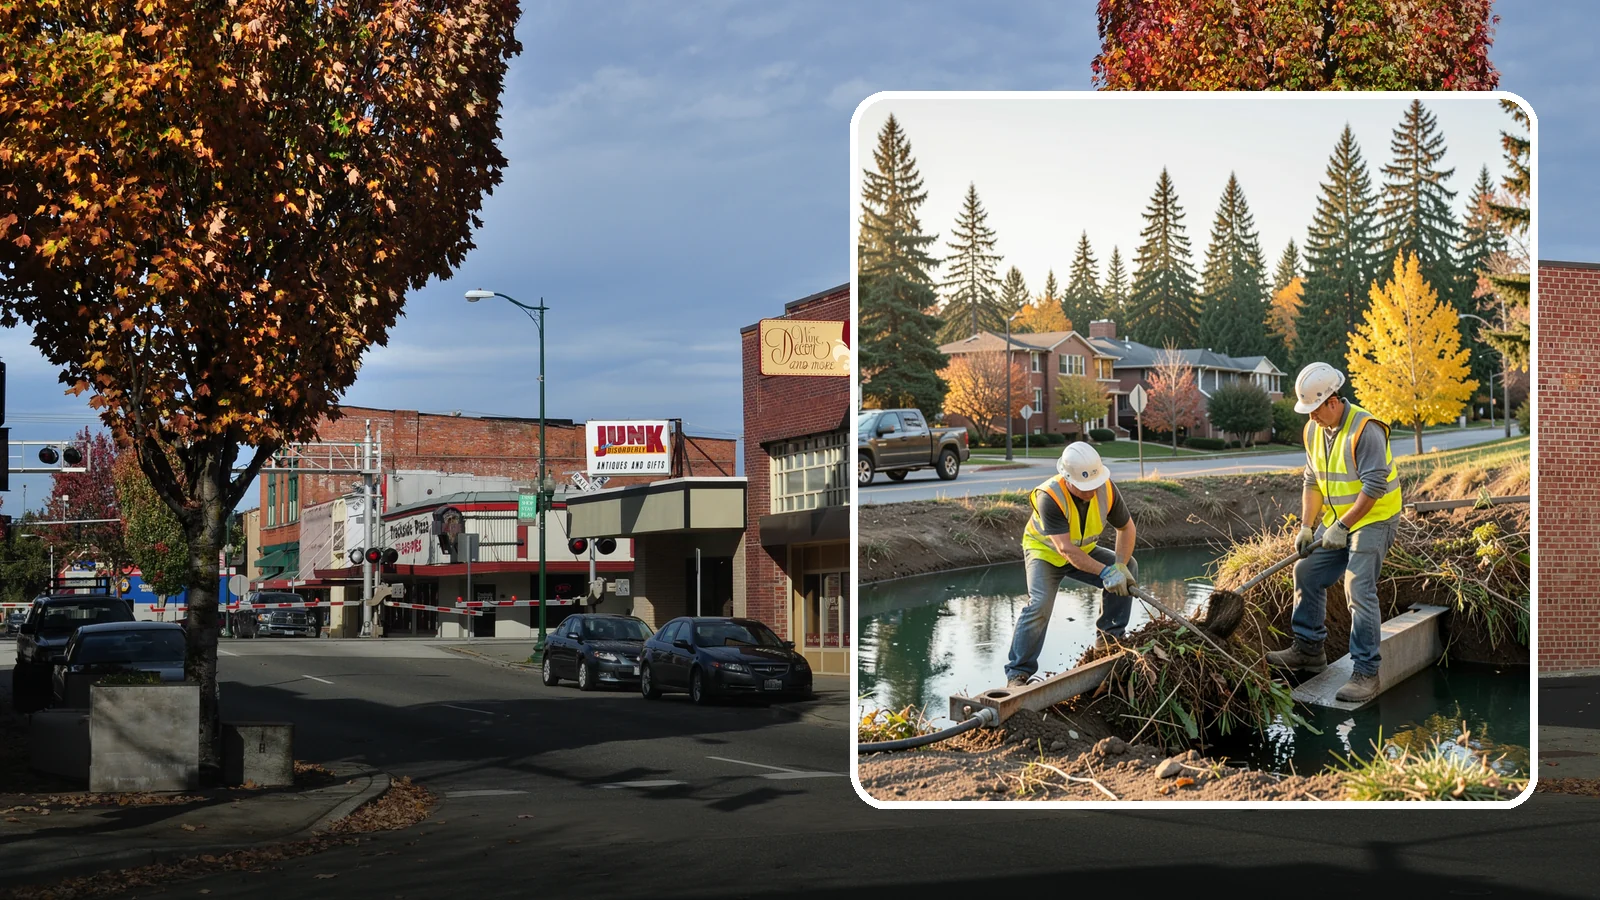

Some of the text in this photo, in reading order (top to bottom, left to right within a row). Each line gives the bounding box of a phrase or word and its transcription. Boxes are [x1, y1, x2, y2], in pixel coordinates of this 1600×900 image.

[595, 425, 665, 457] JUNK
[607, 446, 646, 454] DISORDERLY
[597, 460, 665, 470] ANTIQUES AND GIFTS
[390, 519, 429, 540] Trackside Pizza
